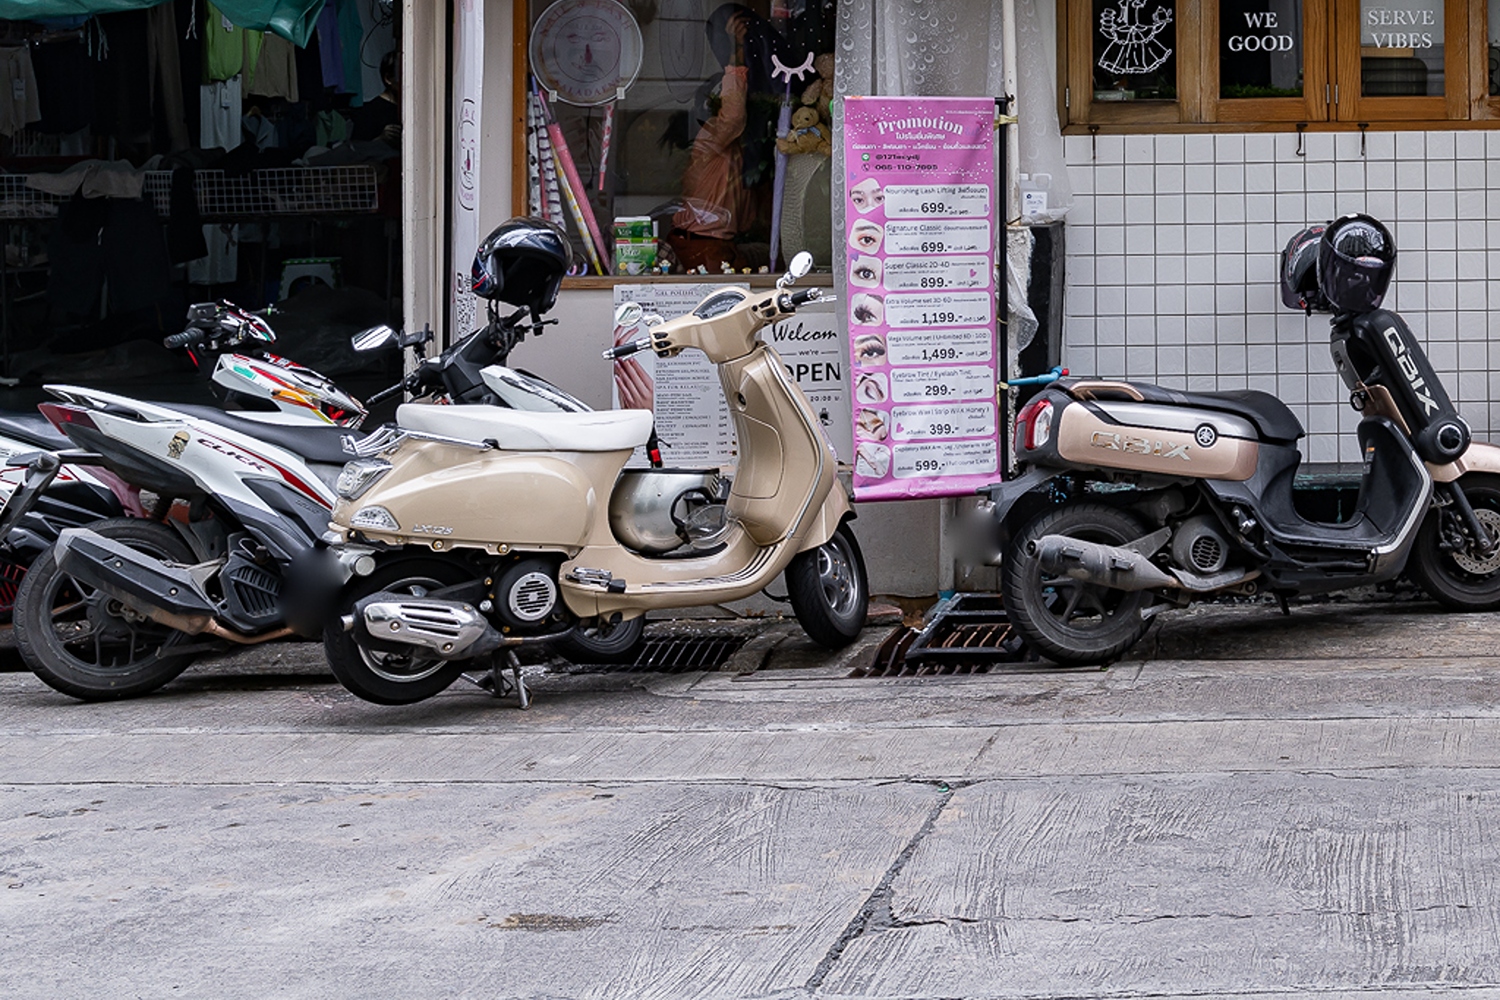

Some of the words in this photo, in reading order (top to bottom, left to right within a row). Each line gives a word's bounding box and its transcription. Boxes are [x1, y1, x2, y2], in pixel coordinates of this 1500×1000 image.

[1244, 12, 1278, 27] WE
[1367, 10, 1434, 26] SERVE
[1228, 34, 1294, 53] GOOD
[1371, 32, 1432, 49] VIBES
[877, 116, 964, 135] Promotion
[922, 313, 962, 325] 1,199.-
[922, 349, 963, 361] 1,499.-
[1383, 326, 1439, 416] QBIX
[925, 385, 956, 396] 299.-
[930, 424, 959, 435] 399.-
[1090, 430, 1192, 461] QBIX
[197, 438, 268, 472] CLICK
[915, 460, 945, 471] 599.-
